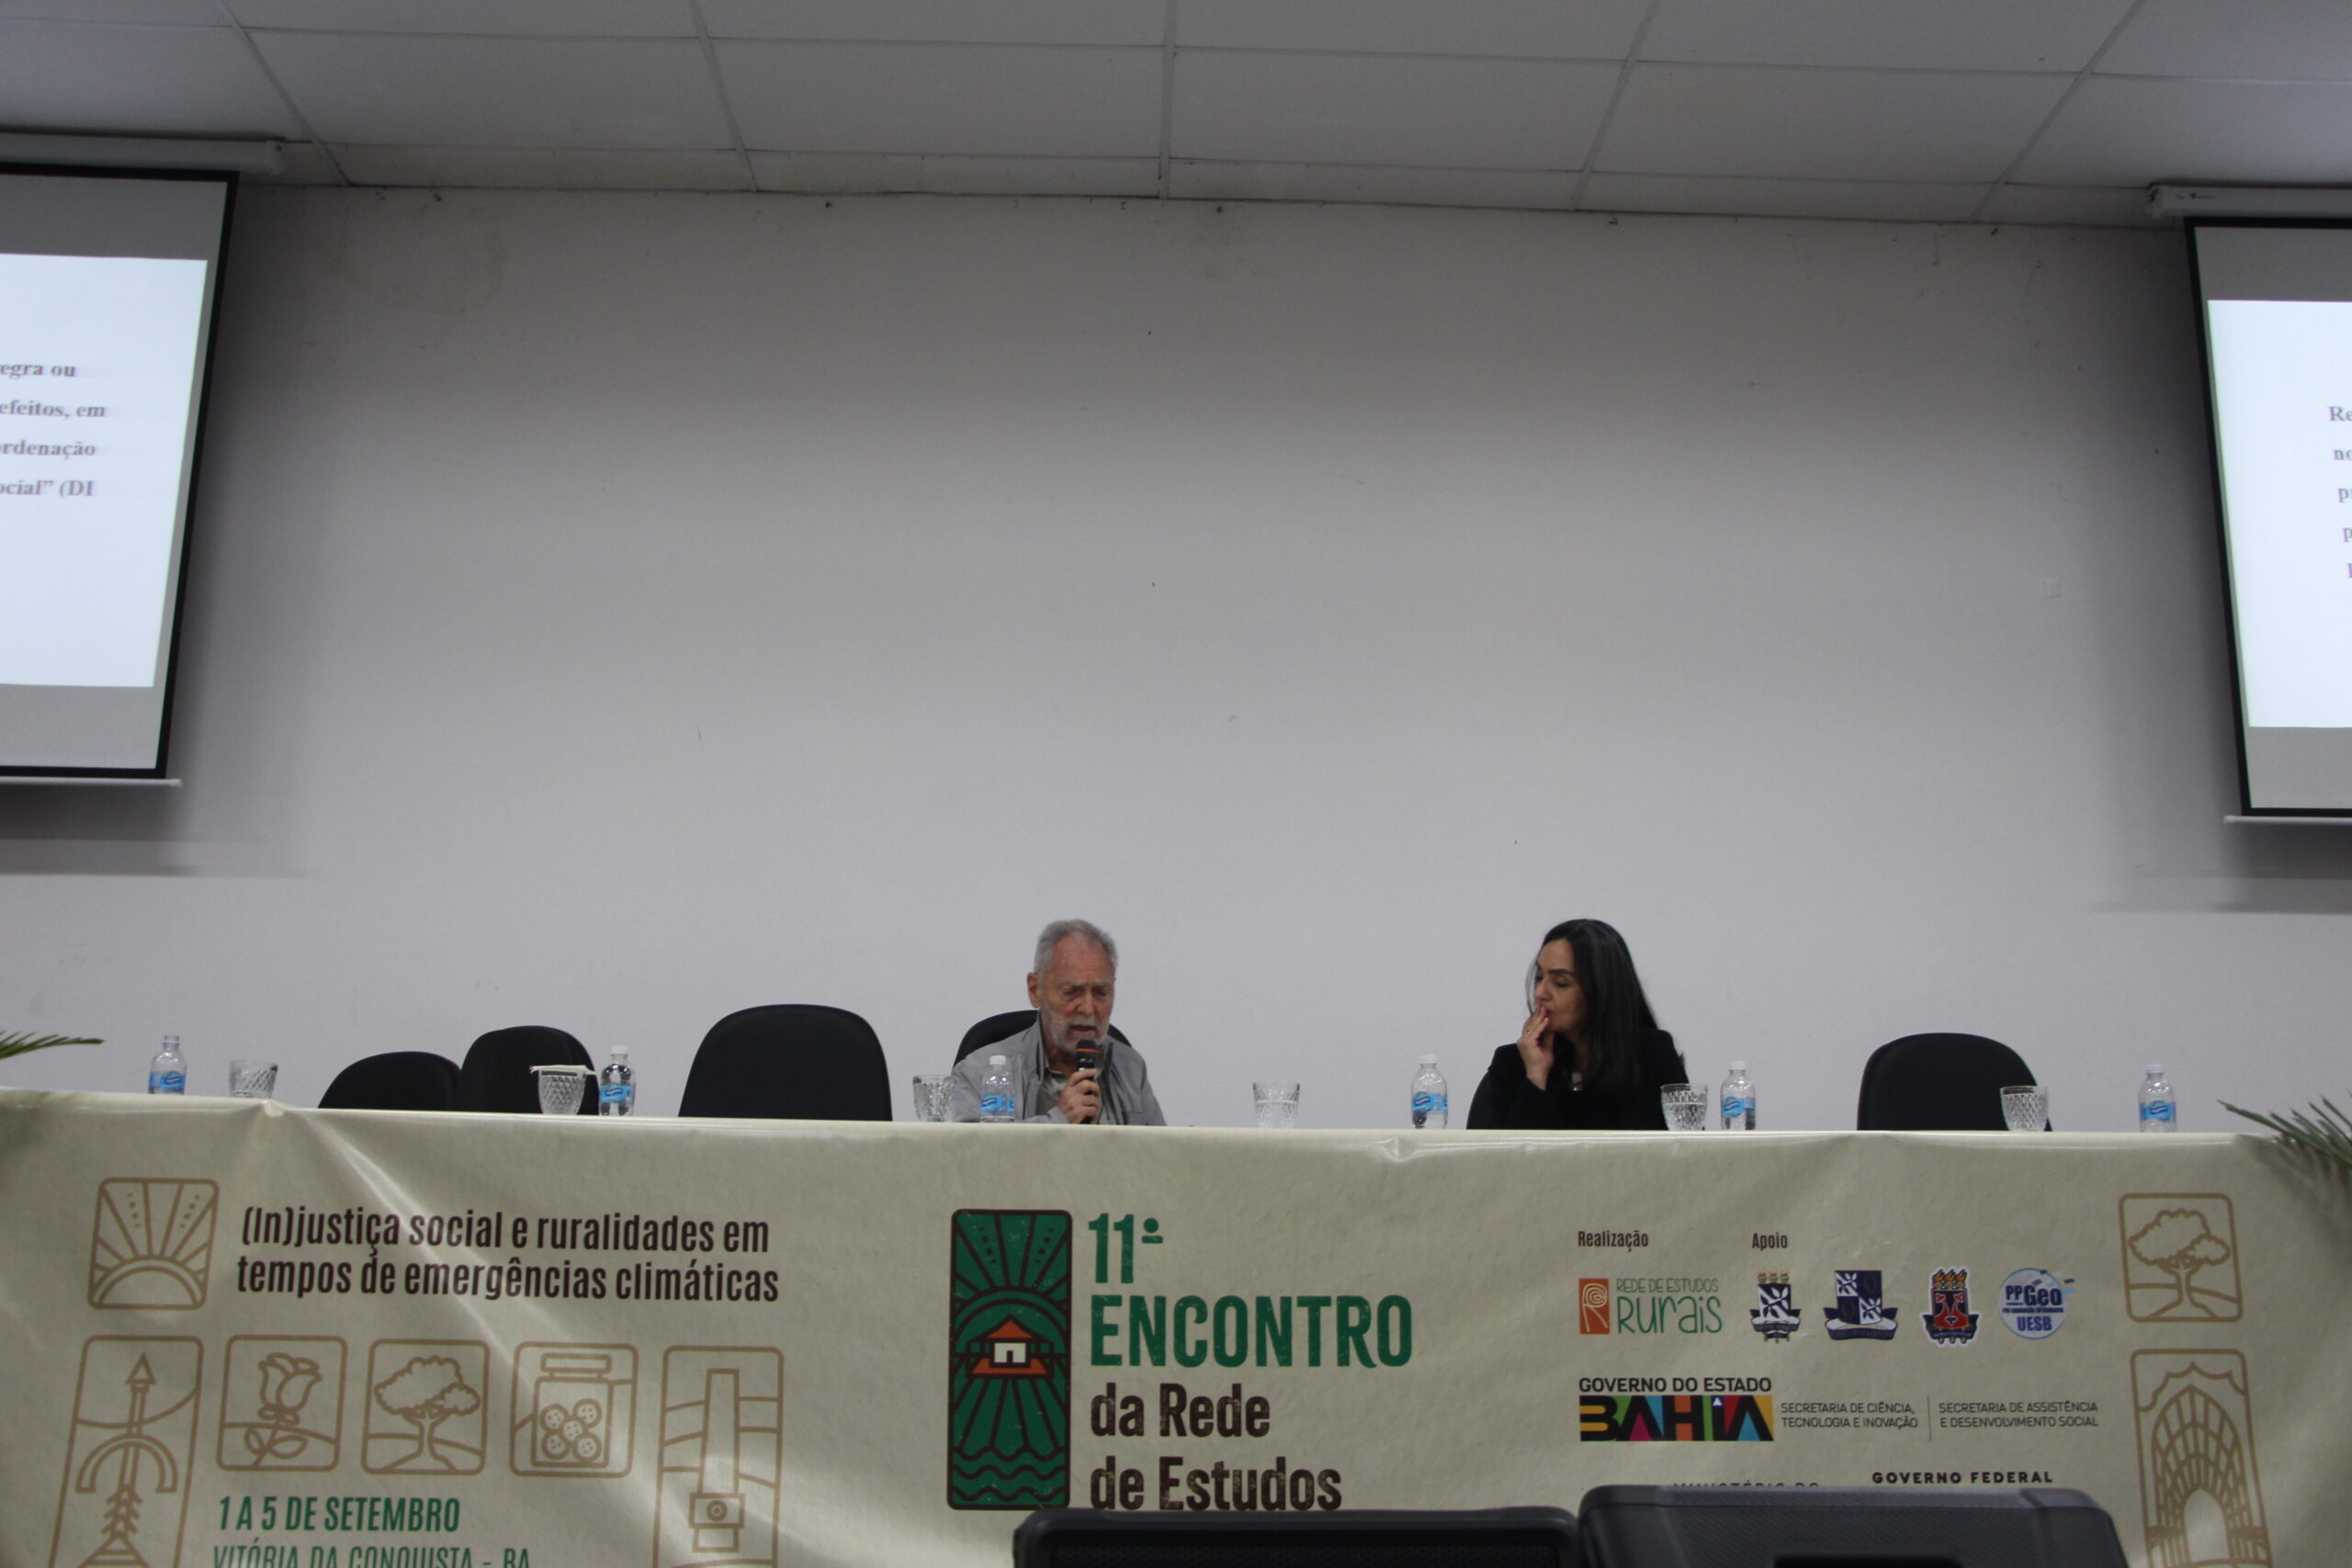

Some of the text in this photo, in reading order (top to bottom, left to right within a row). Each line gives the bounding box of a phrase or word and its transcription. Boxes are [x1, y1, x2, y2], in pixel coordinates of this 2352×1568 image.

[0, 364, 76, 378] egra ou
[76, 405, 106, 418] em
[0, 439, 96, 460] rdenação
[59, 479, 95, 499] (DI
[243, 1205, 769, 1258] (In)justiça social e ruralidades em
[1577, 1229, 1649, 1253] Realização
[1752, 1232, 1789, 1251] Apoio
[237, 1256, 779, 1302] tempos de emergências climáticas
[1616, 1278, 1720, 1293] REDE DE ESTUDOS
[1090, 1294, 1413, 1369] ENCONTRO
[2017, 1315, 2052, 1332] UESB
[1578, 1377, 1772, 1393] GOVERNO DO ESTADO
[1090, 1382, 1272, 1438] da Rede
[1781, 1401, 1916, 1415] SECRETARIA DE CIÊNCIA,
[1939, 1400, 2098, 1414] SECRETARIA DE ASSISTÊNCIA
[1579, 1395, 1774, 1441] BAHIA
[1781, 1416, 1918, 1430] TECNOLOGIA E INOVAÇÃO
[1940, 1416, 2099, 1427] E DESENVOLVIMENTO SOCIAL
[1090, 1455, 1343, 1512] de Estudos
[1871, 1471, 2053, 1484] GOVERNO FEDERAL
[220, 1495, 460, 1532] 1 A 5 DE SETEMBRO
[213, 1536, 299, 1568] VITÓRIA
[309, 1545, 337, 1568] DA
[503, 1547, 530, 1568] BA
